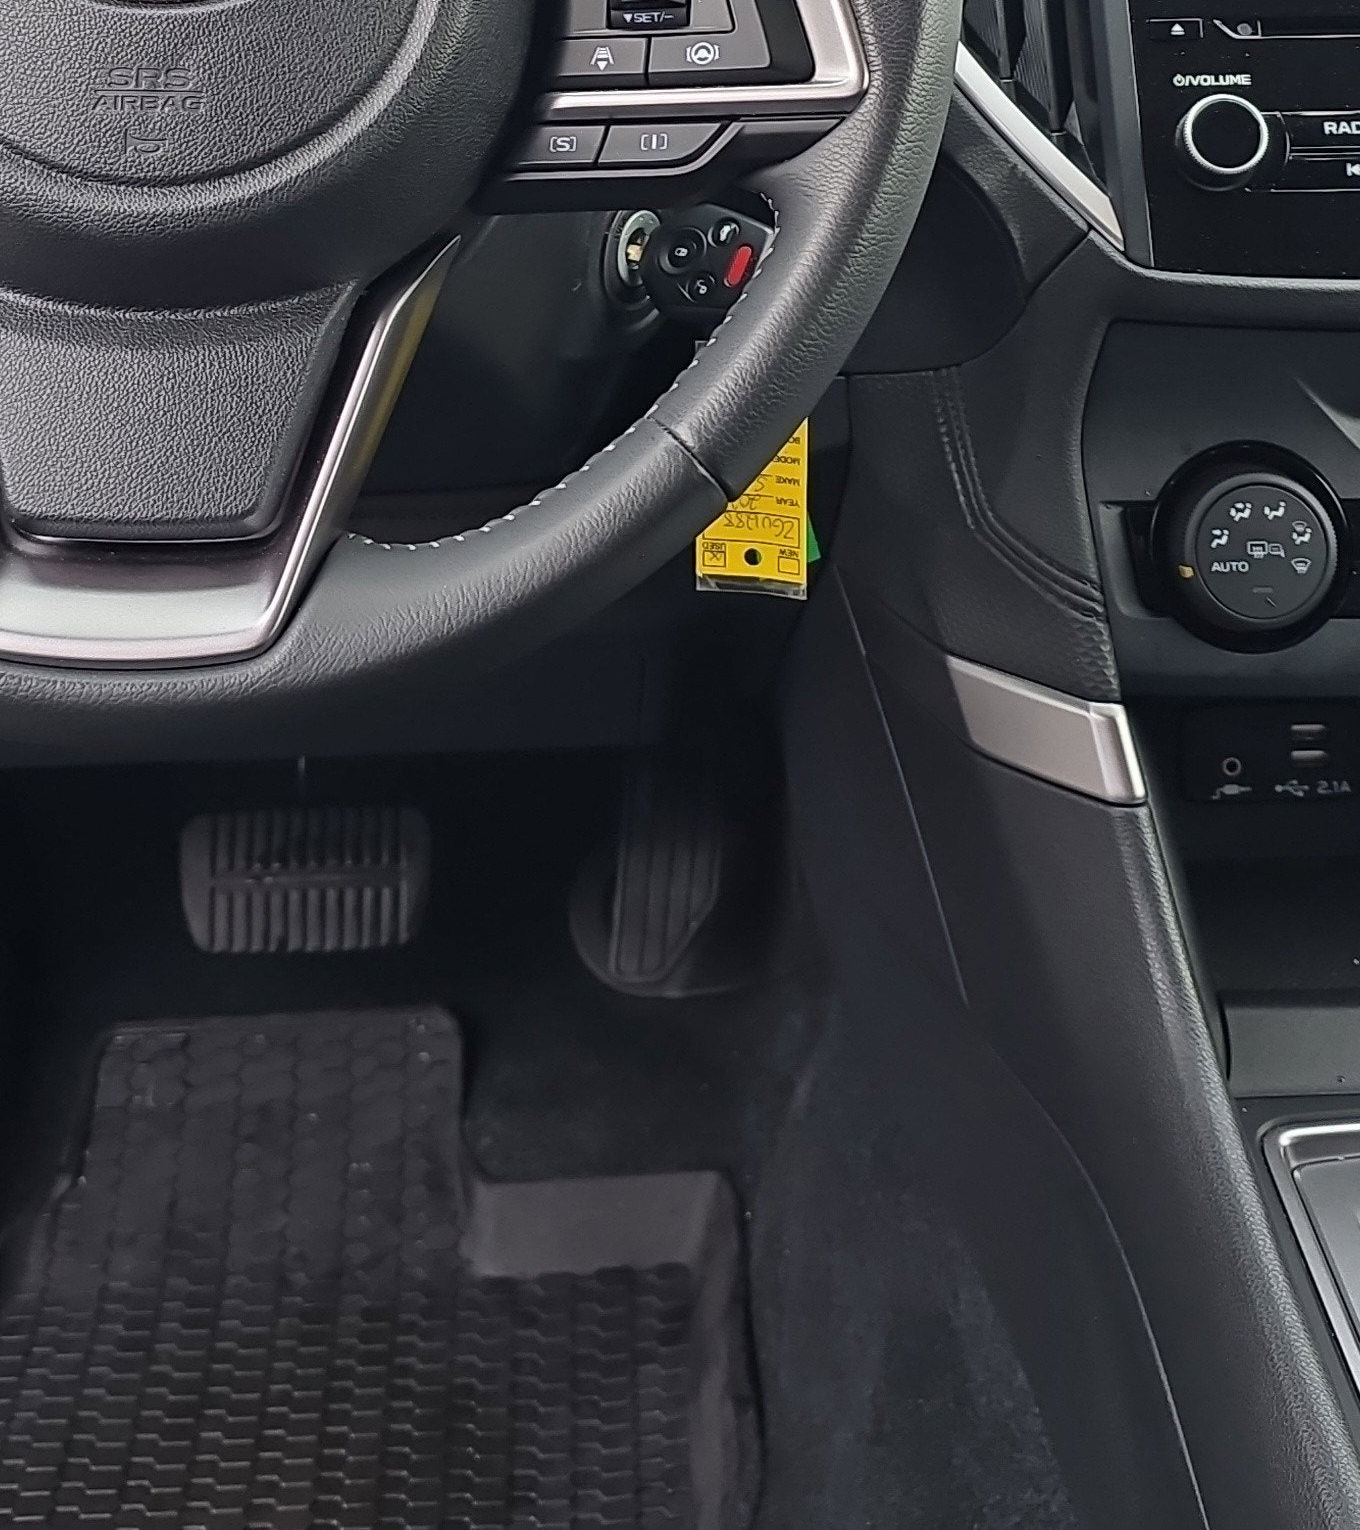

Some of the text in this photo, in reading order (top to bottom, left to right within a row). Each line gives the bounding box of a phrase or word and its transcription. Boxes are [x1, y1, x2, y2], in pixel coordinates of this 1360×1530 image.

[107, 67, 190, 90] SRS
[91, 95, 204, 111] AIRBAG
[772, 455, 801, 466] MODE
[775, 475, 801, 487] MAKE
[775, 497, 801, 509] YEAR
[701, 542, 727, 551] USED
[779, 548, 799, 559] NEW
[1210, 559, 1250, 574] AUTO
